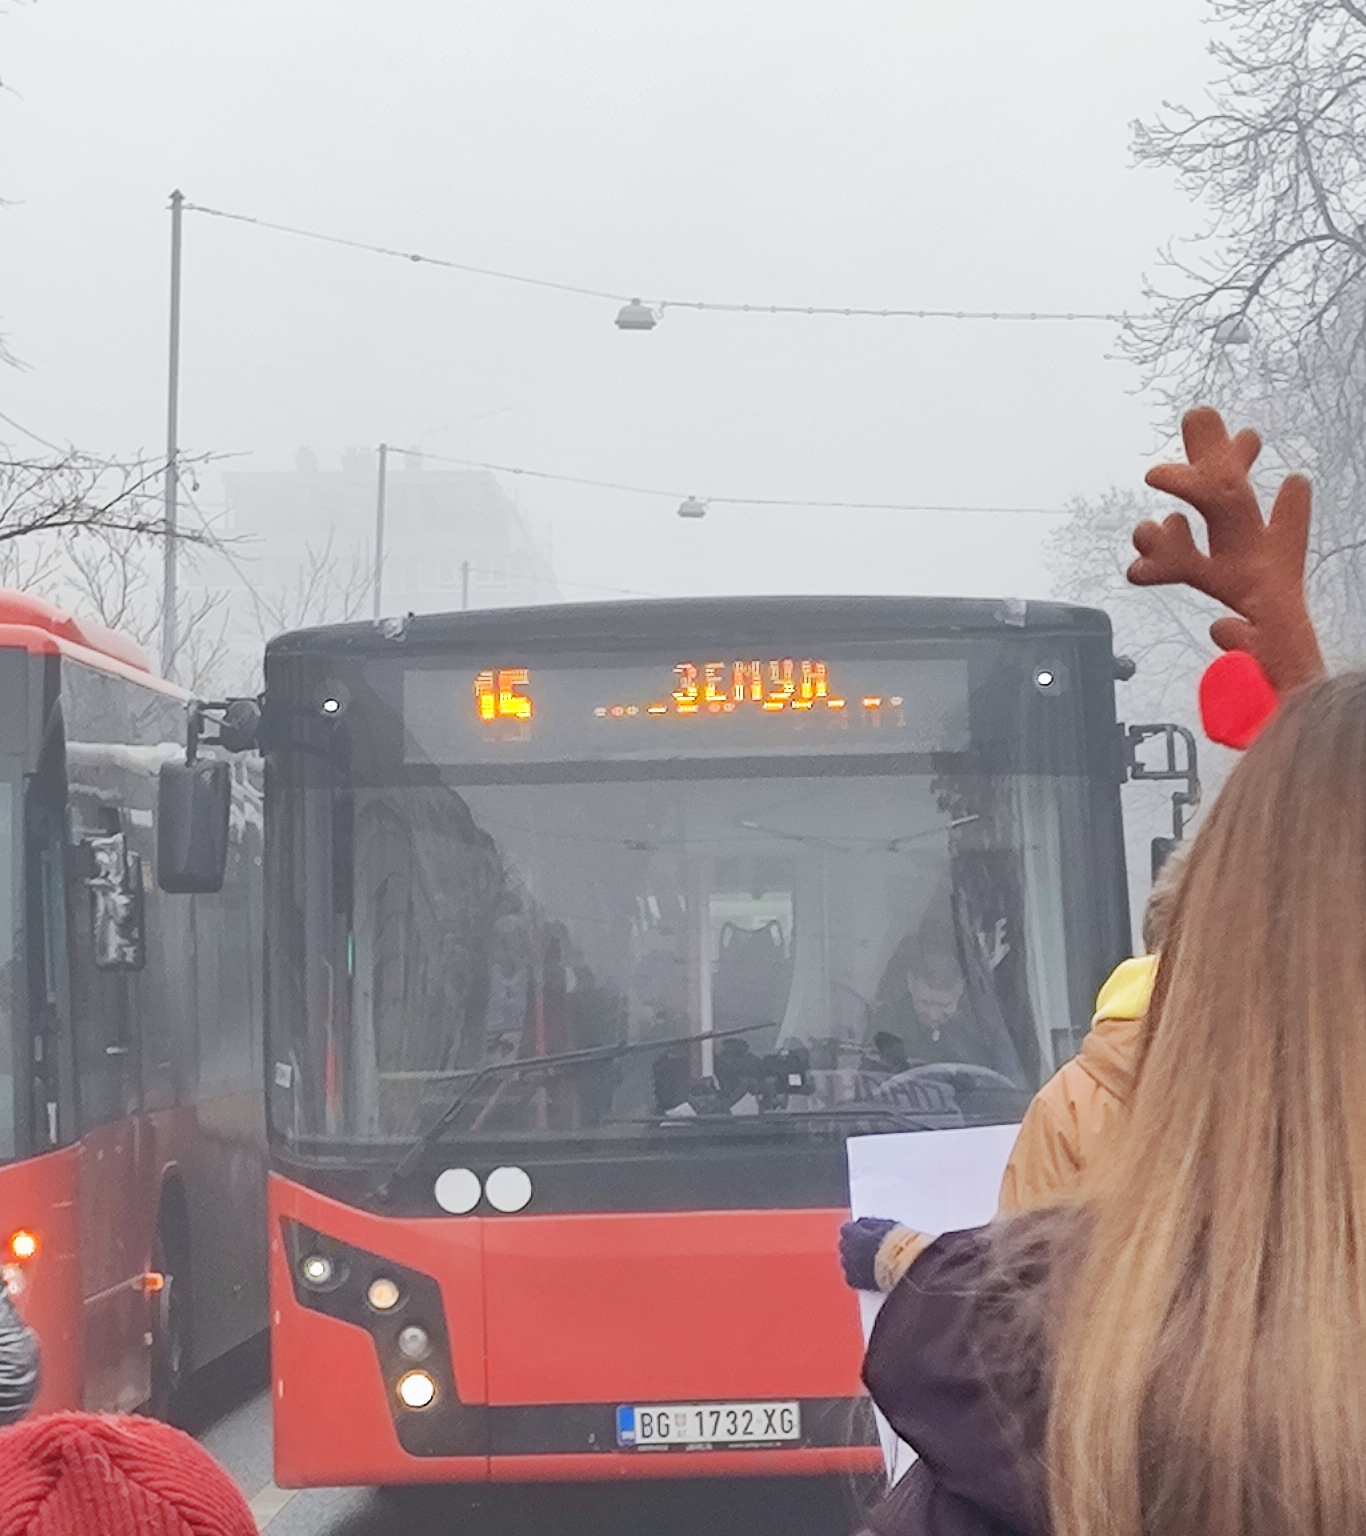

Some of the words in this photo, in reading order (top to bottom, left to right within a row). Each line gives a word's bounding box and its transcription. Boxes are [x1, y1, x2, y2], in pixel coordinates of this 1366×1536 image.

[640, 1412, 670, 1438] BG
[695, 1410, 754, 1436] 1732
[763, 1408, 794, 1434] XG
